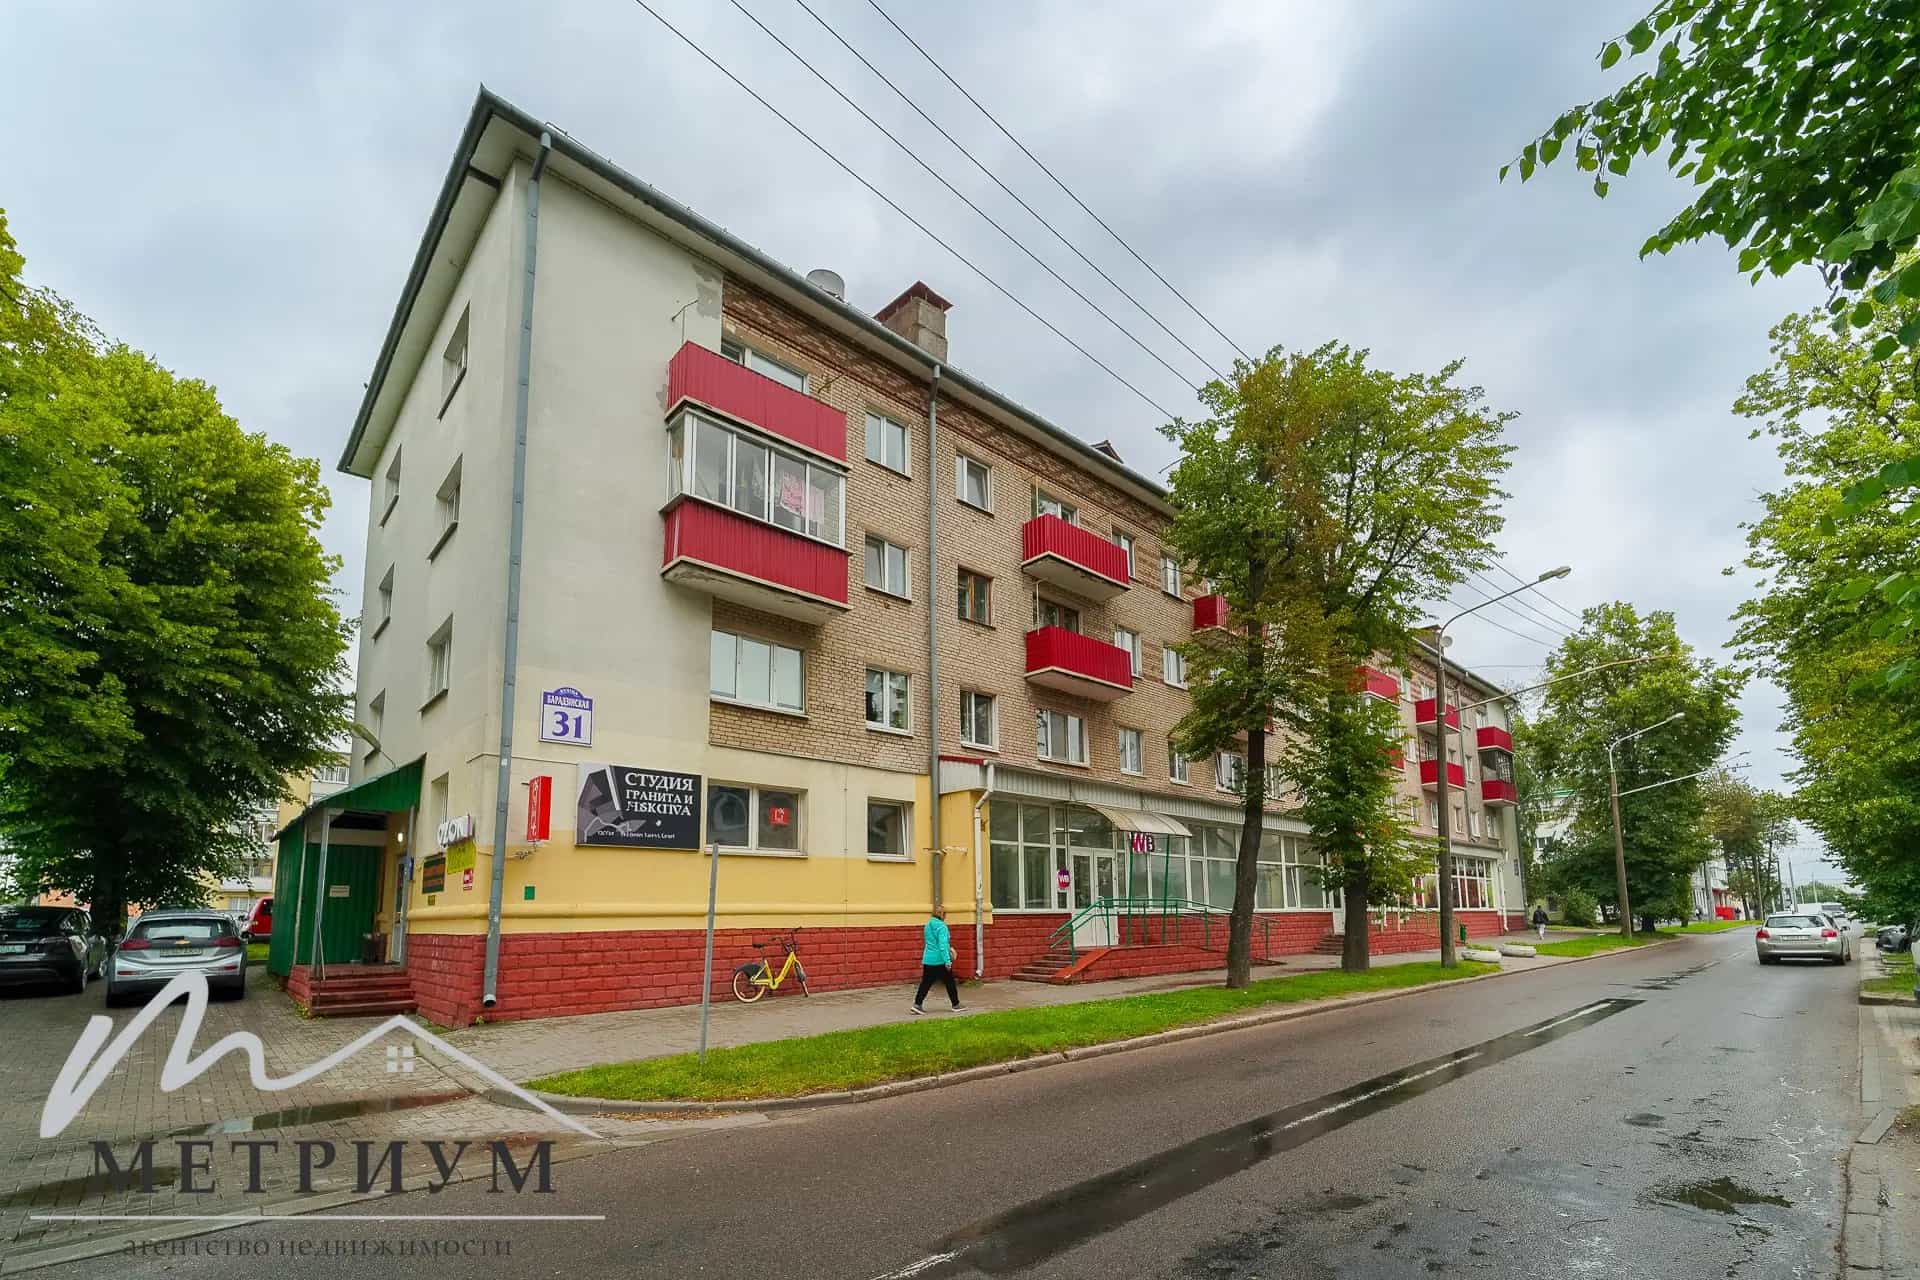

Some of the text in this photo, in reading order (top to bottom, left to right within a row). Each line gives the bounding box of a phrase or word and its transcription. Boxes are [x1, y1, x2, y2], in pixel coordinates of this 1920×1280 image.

[552, 711, 583, 738] 31
[624, 772, 694, 792] СТУДИЯ
[626, 789, 693, 804] ГРАНИТА И
[437, 819, 465, 846] OZON
[1129, 832, 1154, 854] WB
[1059, 874, 1070, 884] WB
